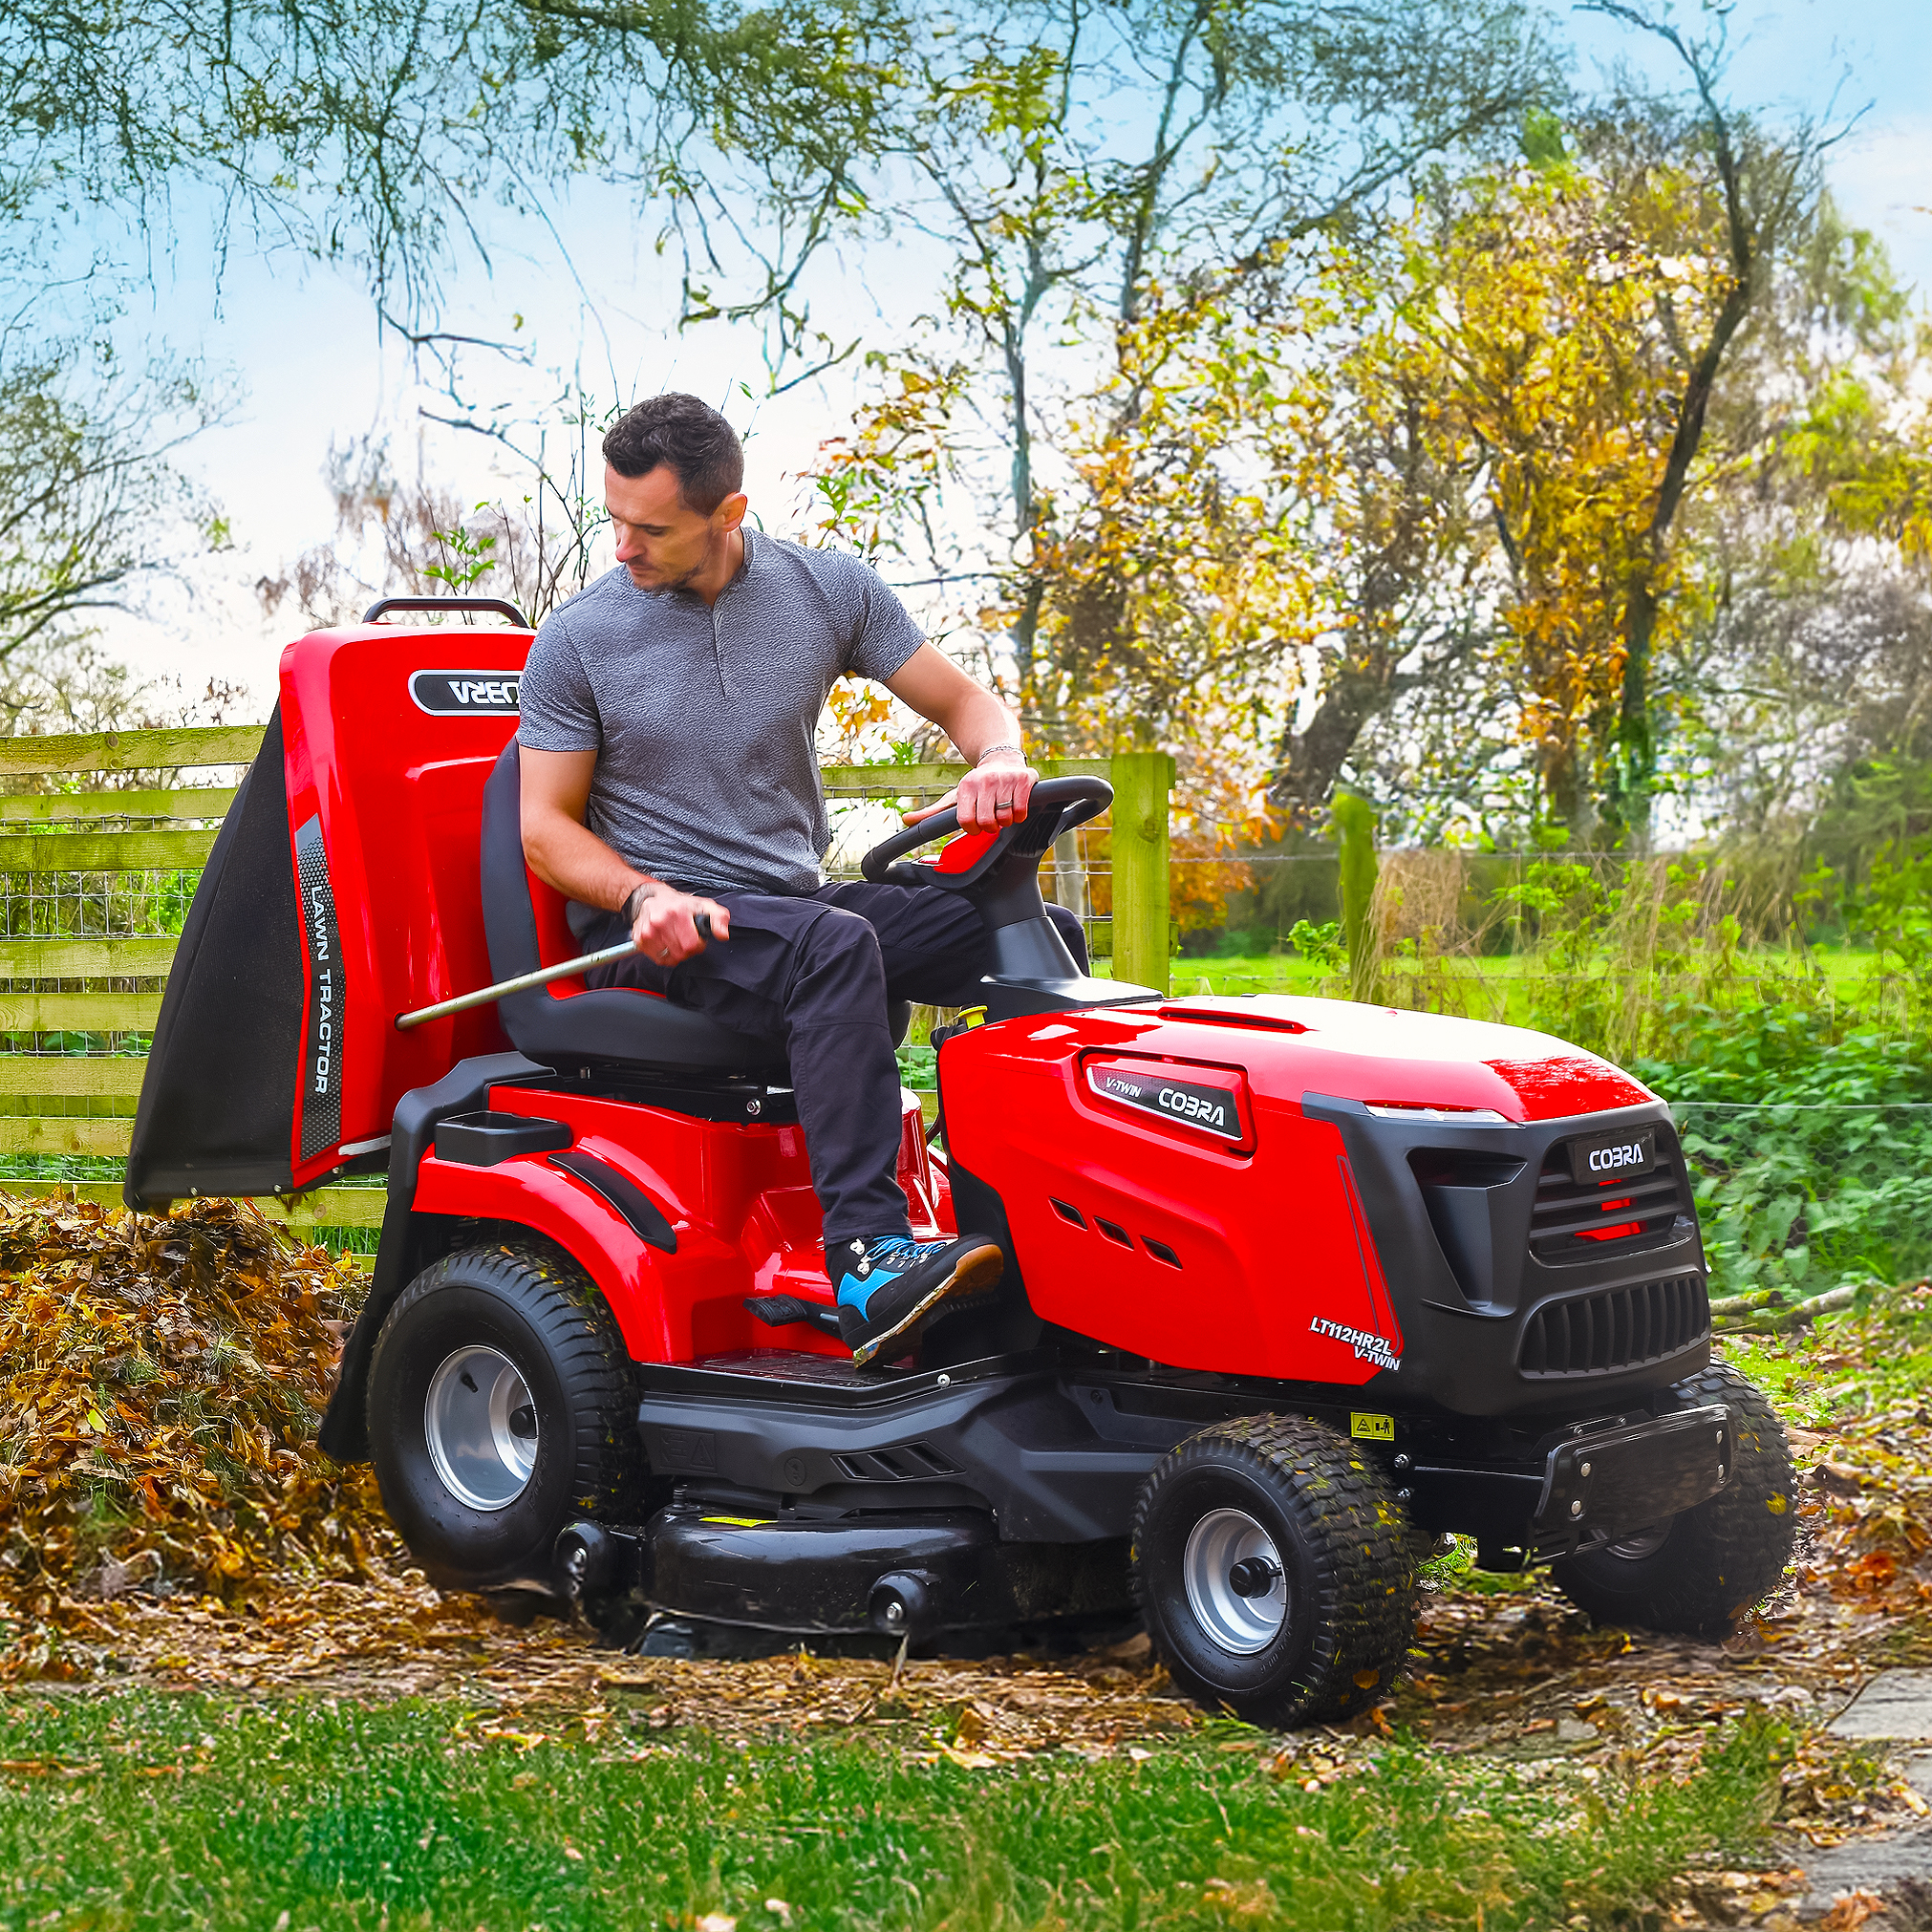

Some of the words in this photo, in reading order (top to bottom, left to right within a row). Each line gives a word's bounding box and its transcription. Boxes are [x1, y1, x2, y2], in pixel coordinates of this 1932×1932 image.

[311, 885, 330, 961] LAWN
[314, 968, 332, 1094] TRACTOR
[1106, 1076, 1143, 1098] V-TWIN
[1158, 1087, 1225, 1127] COBRA
[1589, 1143, 1644, 1171] COBRA
[1310, 1316, 1393, 1356] LT112HR2L
[1354, 1345, 1401, 1371] V-TWIN
